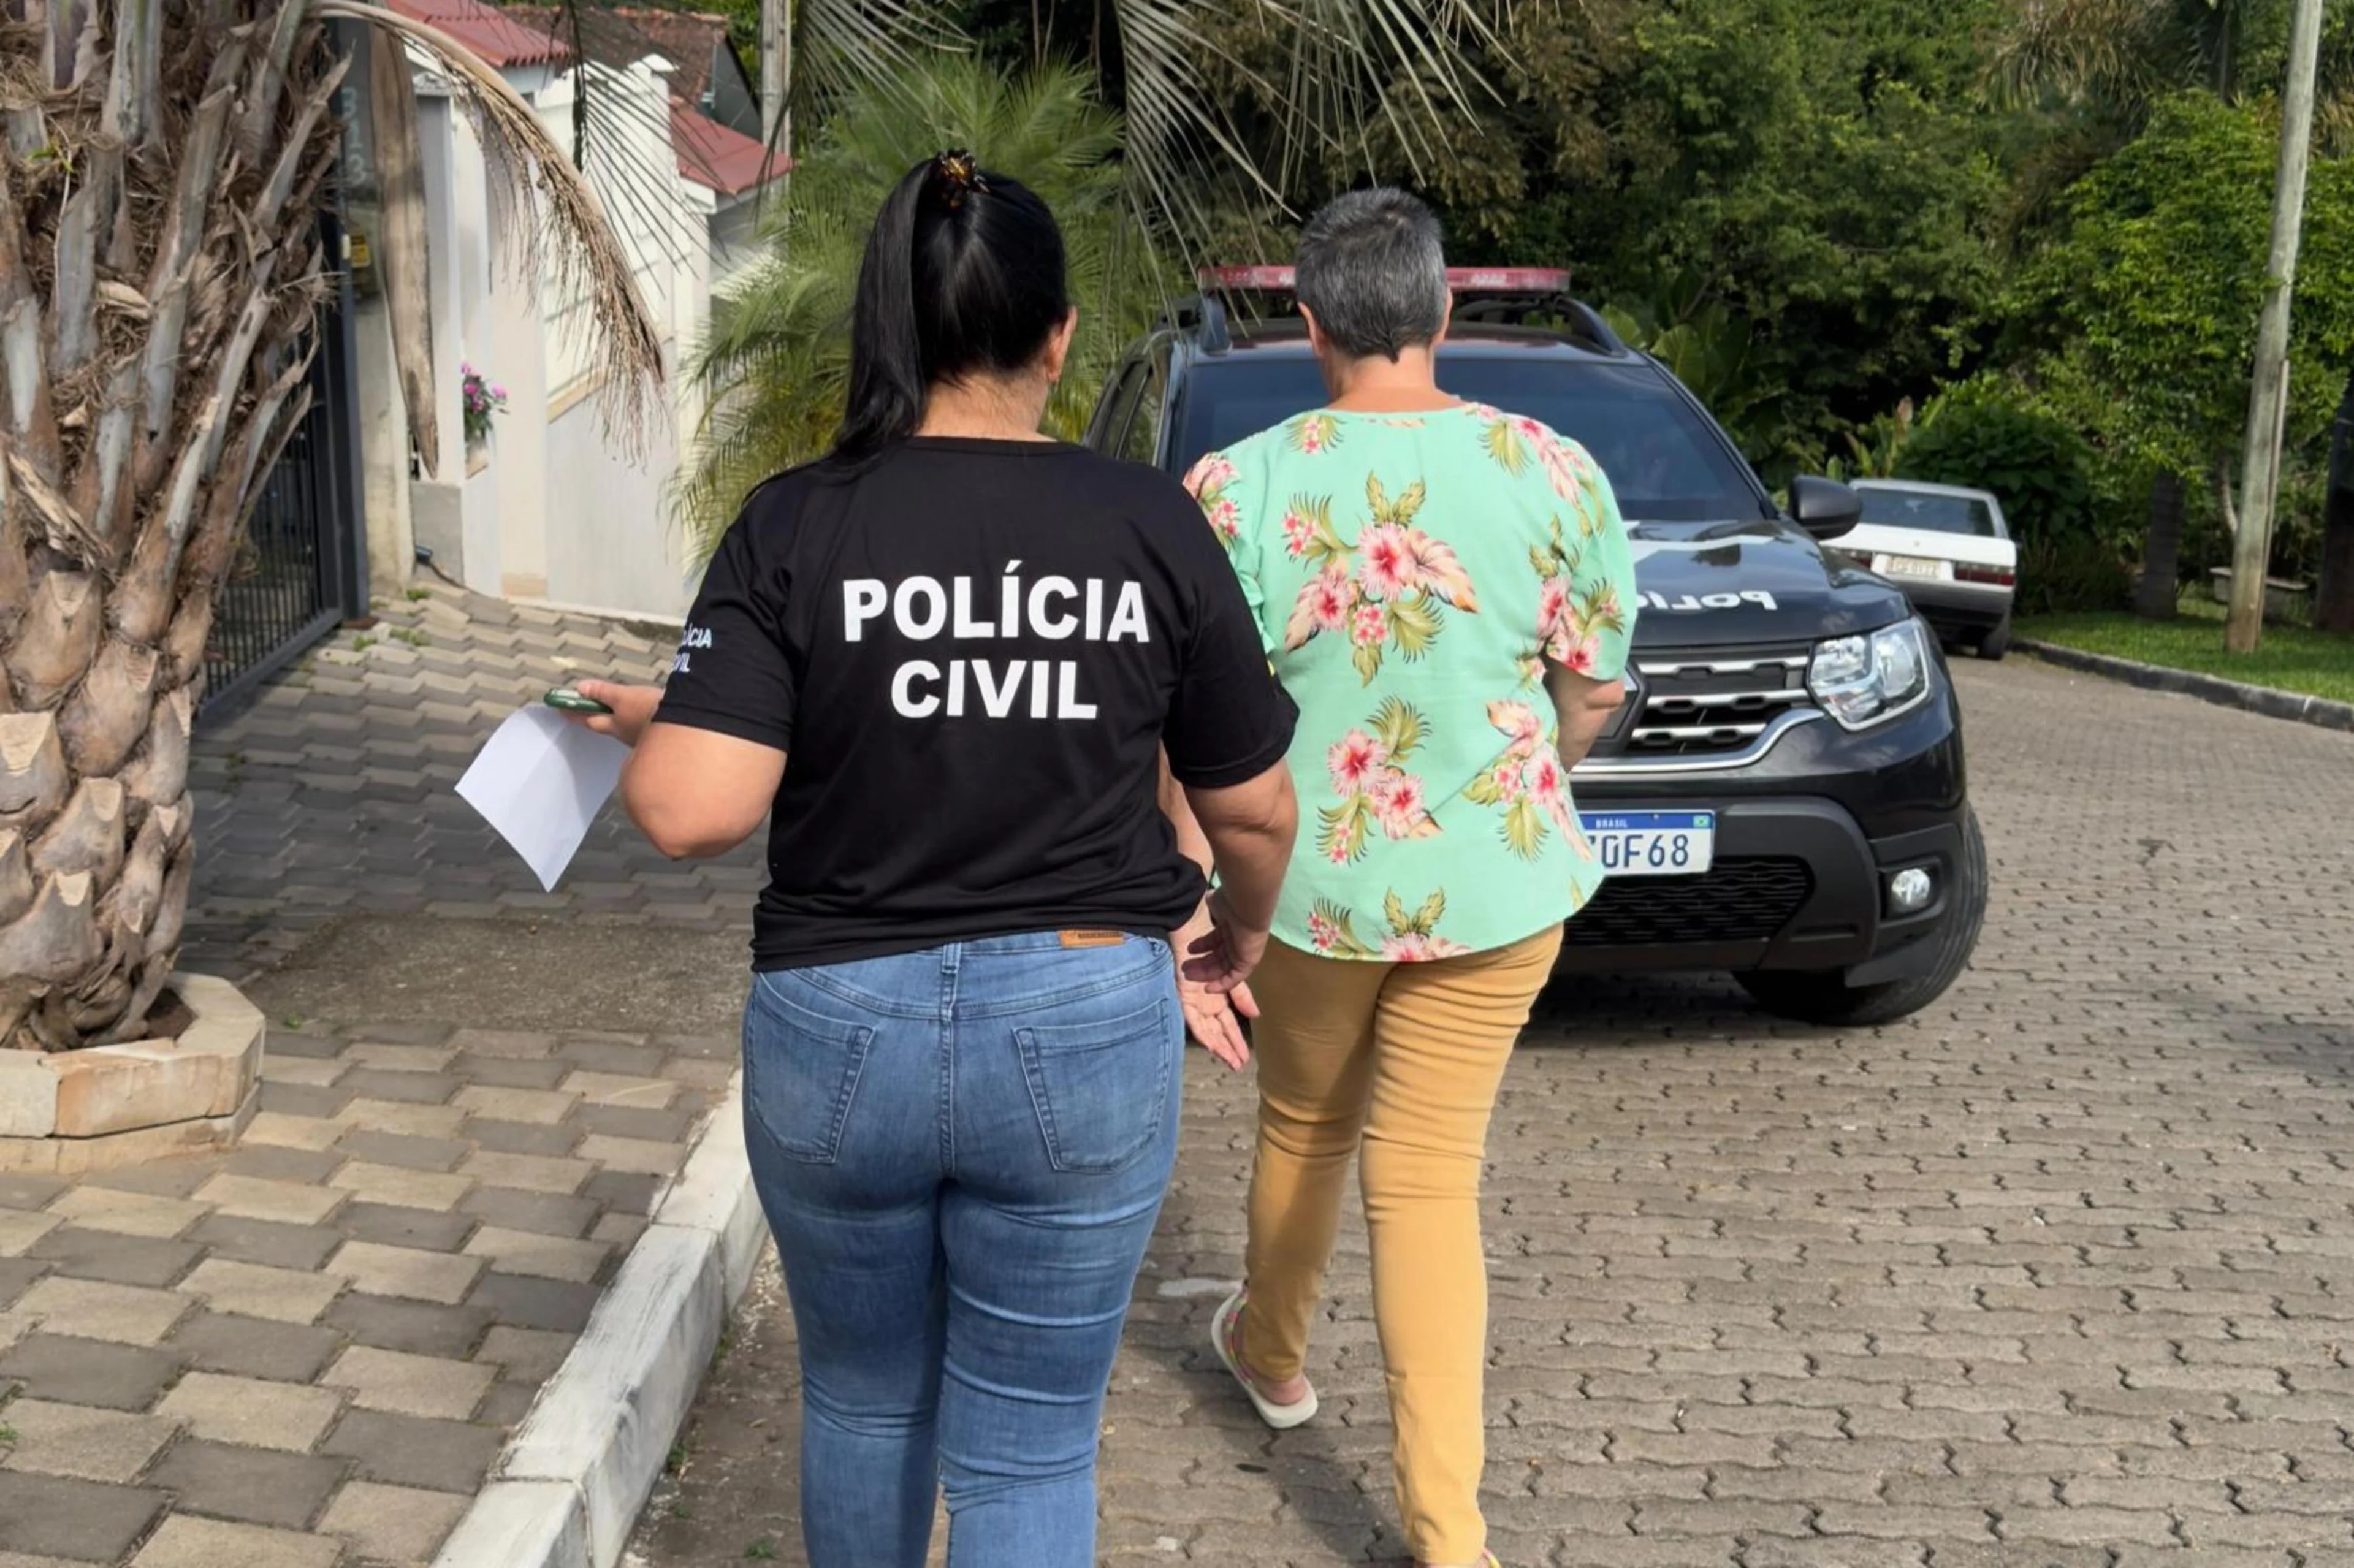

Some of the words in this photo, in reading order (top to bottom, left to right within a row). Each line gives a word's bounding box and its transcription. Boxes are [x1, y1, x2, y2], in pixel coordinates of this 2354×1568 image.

[842, 560, 1150, 643] POLÍCIA
[891, 659, 1098, 720] CIVIL
[1596, 818, 1628, 829] BRASIL
